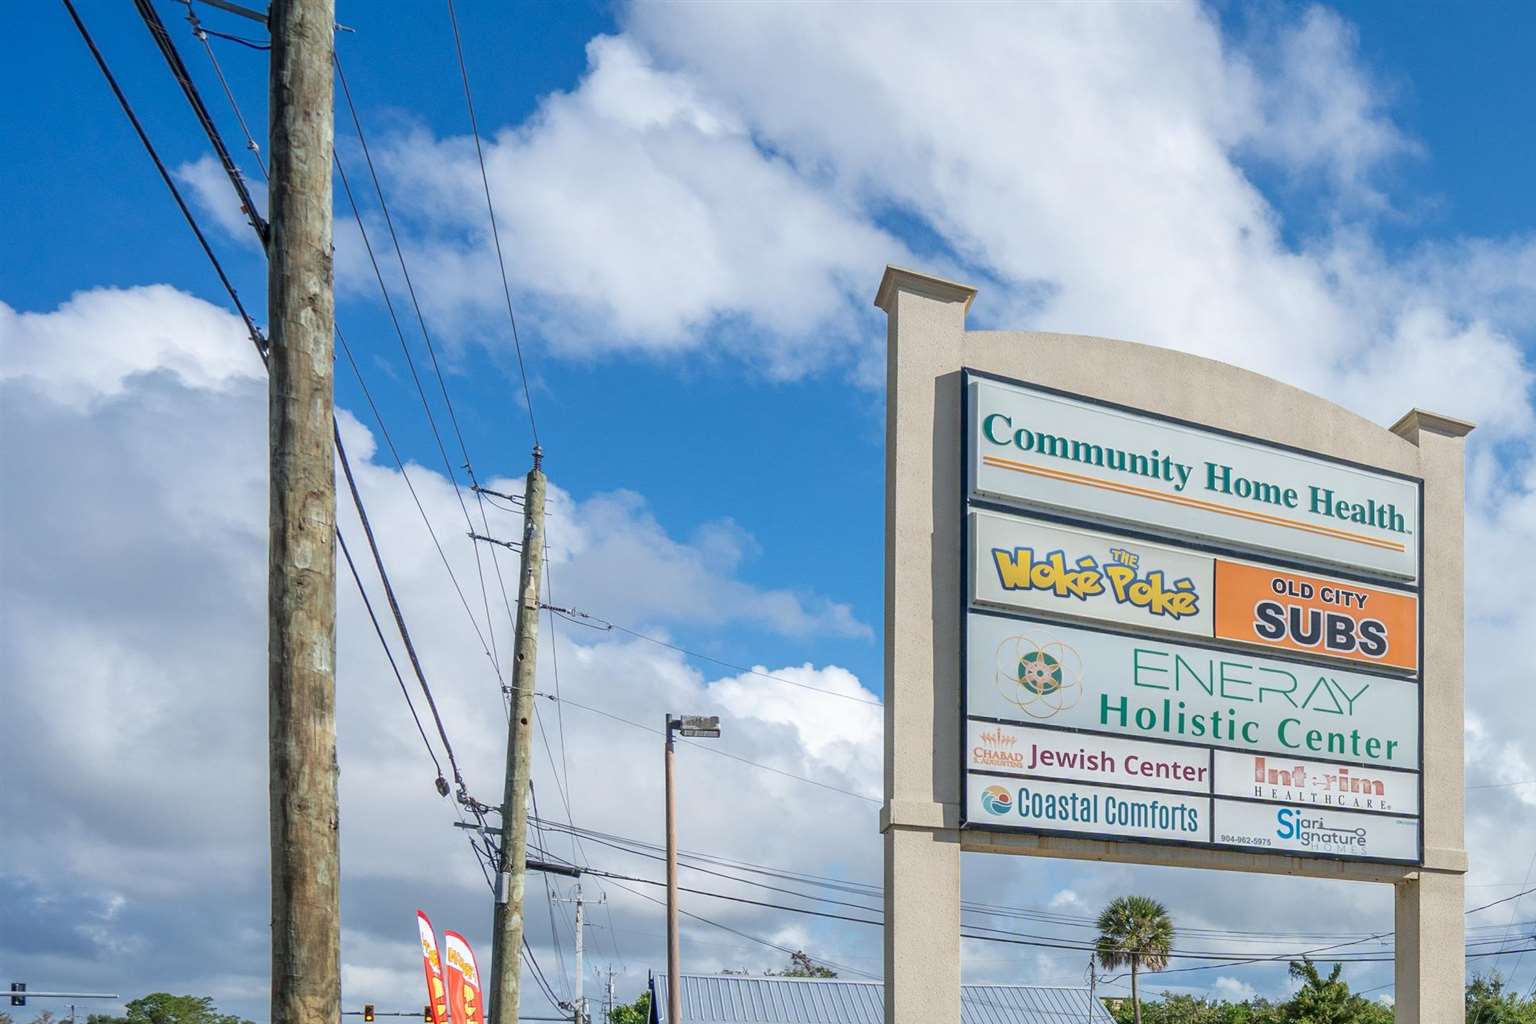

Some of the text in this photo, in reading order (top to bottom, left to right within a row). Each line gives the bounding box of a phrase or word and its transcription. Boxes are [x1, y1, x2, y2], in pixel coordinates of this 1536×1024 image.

[983, 413, 1406, 533] Community Home Health
[1272, 577, 1369, 609] OLD CITY
[1254, 601, 1388, 657] SUBS
[1134, 648, 1370, 716] ENERAY
[1101, 694, 1398, 760] Holistic Center
[1028, 744, 1207, 782] Jewish Center
[1018, 787, 1198, 832] Coastal Comforts
[1254, 786, 1386, 810] HEALTHCARE
